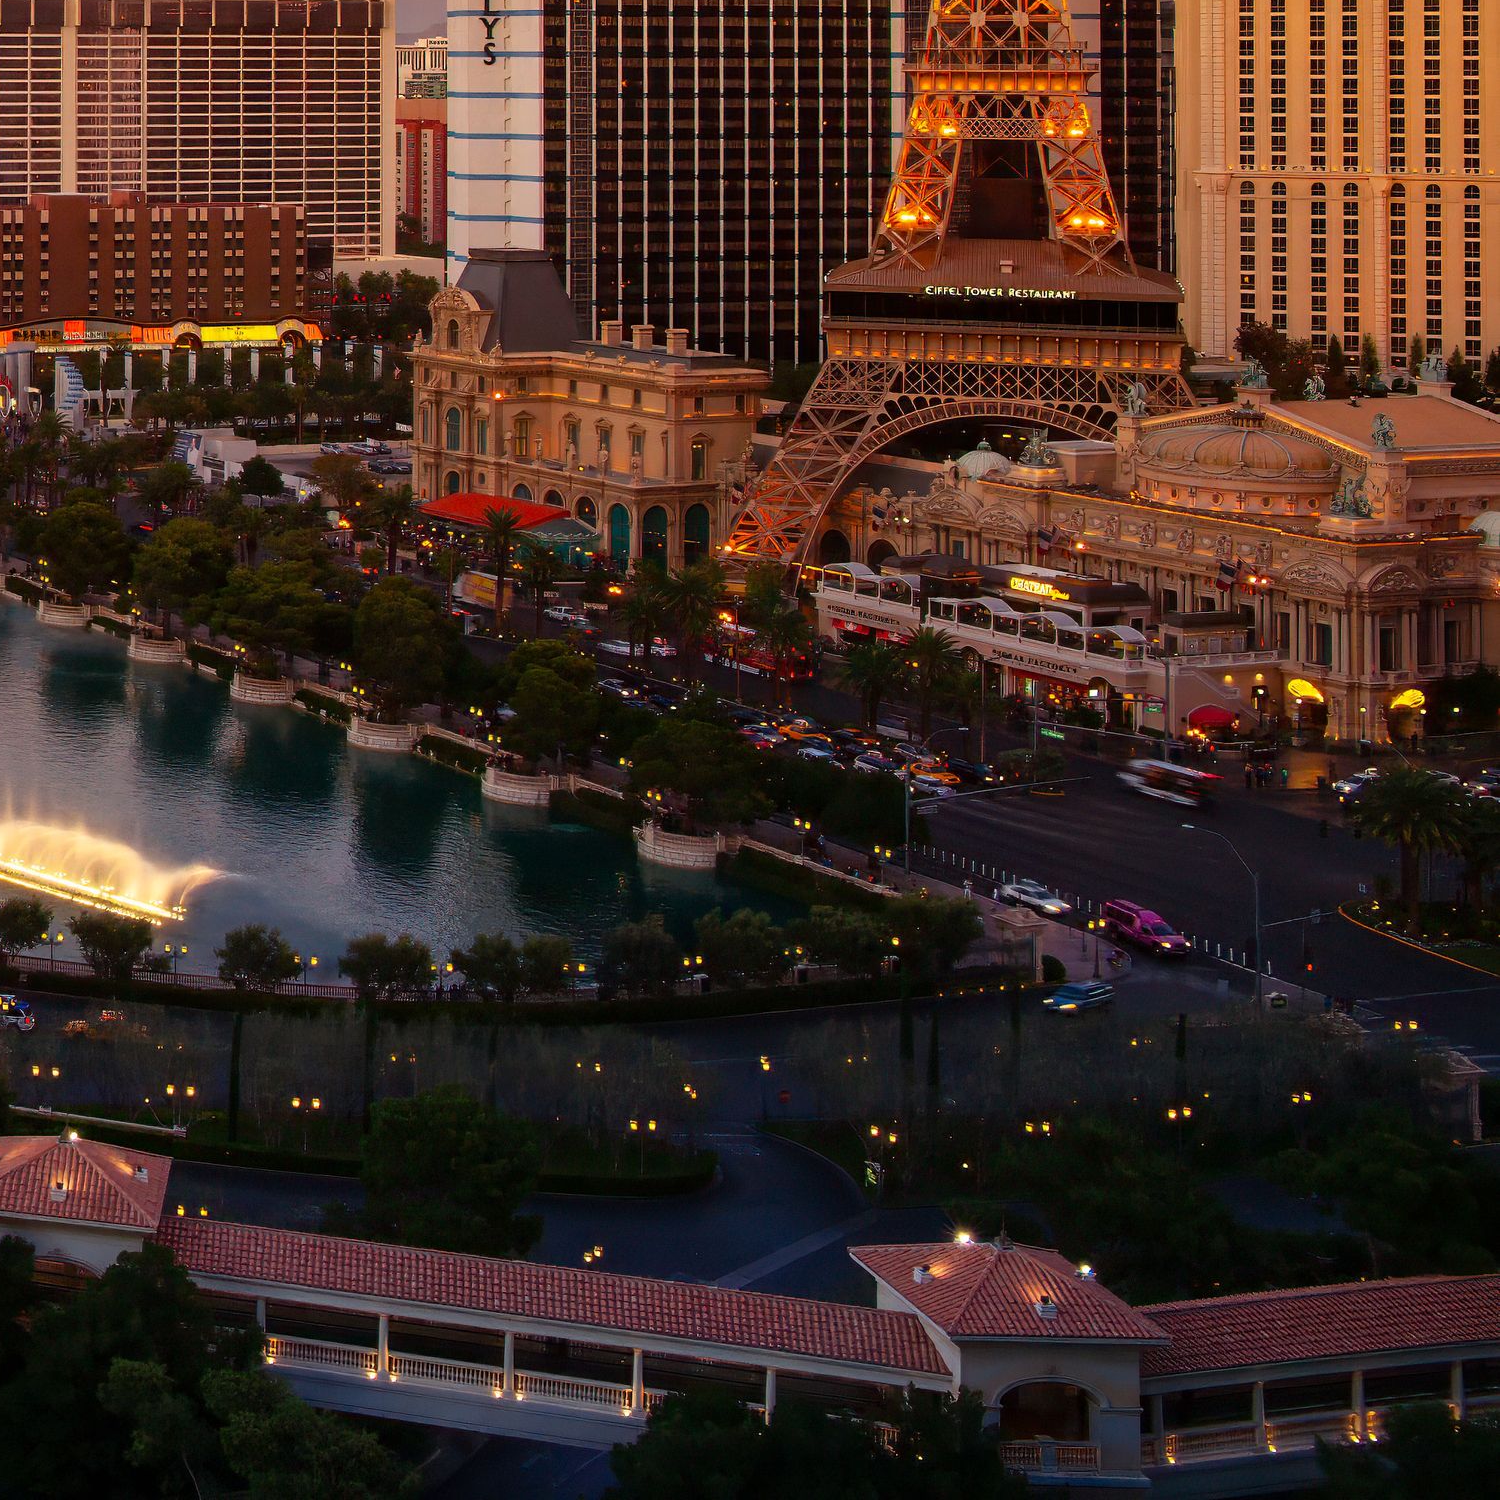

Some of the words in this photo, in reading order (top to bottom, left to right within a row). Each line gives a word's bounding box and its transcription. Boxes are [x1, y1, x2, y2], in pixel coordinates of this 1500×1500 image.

[925, 285, 962, 296] EIFFEL
[964, 286, 1003, 297] TOWER
[1008, 287, 1077, 300] RESTAURANT
